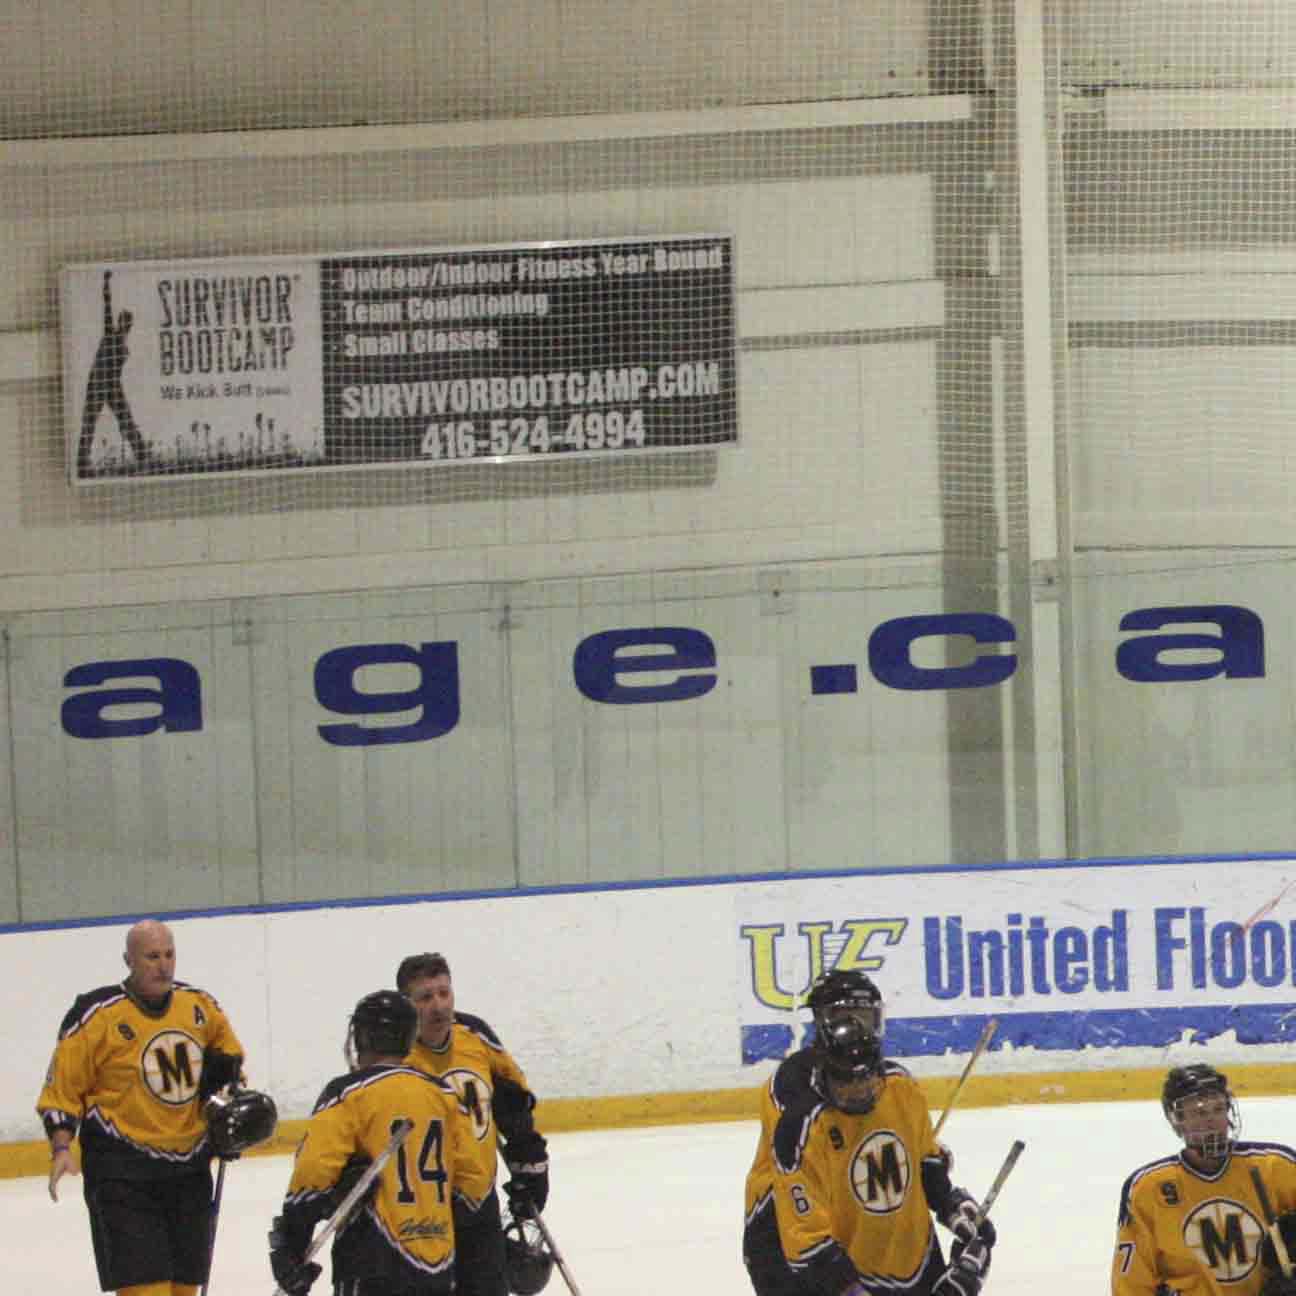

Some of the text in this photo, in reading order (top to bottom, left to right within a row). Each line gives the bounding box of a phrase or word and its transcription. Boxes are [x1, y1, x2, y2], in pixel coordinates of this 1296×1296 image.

[343, 247, 722, 291] Outdoor/Indoor Fitness Year Round
[158, 275, 294, 328] SURVIVOR
[344, 292, 550, 325] Team Conditioning
[160, 325, 294, 376] BOOTCAMP
[344, 328, 499, 357] Small Classes
[342, 362, 720, 418] SURVIVORBOOTCAMP.COM
[421, 409, 646, 459] 416-524-4994
[923, 909, 1128, 1000] United
[154, 1042, 194, 1093] M
[388, 1118, 448, 1204] 14
[866, 1140, 903, 1203] M
[789, 1183, 812, 1216] 6
[1118, 1241, 1136, 1273] 7
[1199, 1212, 1250, 1269] M
